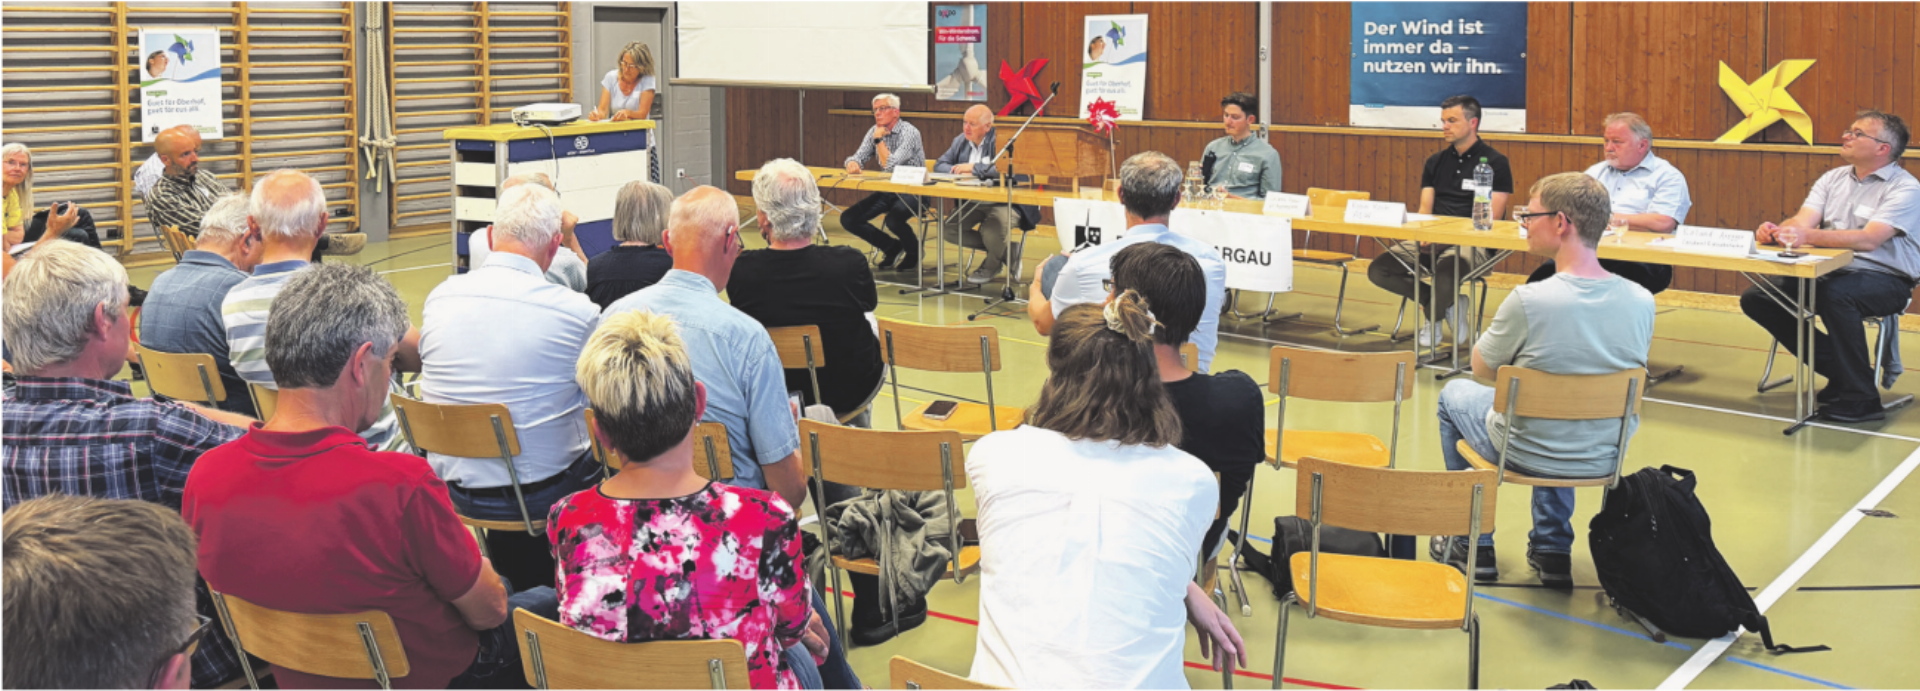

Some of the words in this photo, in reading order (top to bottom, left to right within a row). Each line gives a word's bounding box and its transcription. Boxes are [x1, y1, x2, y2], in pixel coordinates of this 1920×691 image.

[1364, 21, 1397, 35] Der
[1402, 19, 1453, 35] Wind
[1458, 18, 1484, 35] ist
[1363, 39, 1424, 54] immer
[1429, 39, 1453, 54] da
[1363, 60, 1426, 73] nutzen
[1430, 57, 1462, 73] wir
[1466, 57, 1503, 74] ihn.
[1214, 246, 1272, 266] RGAU
